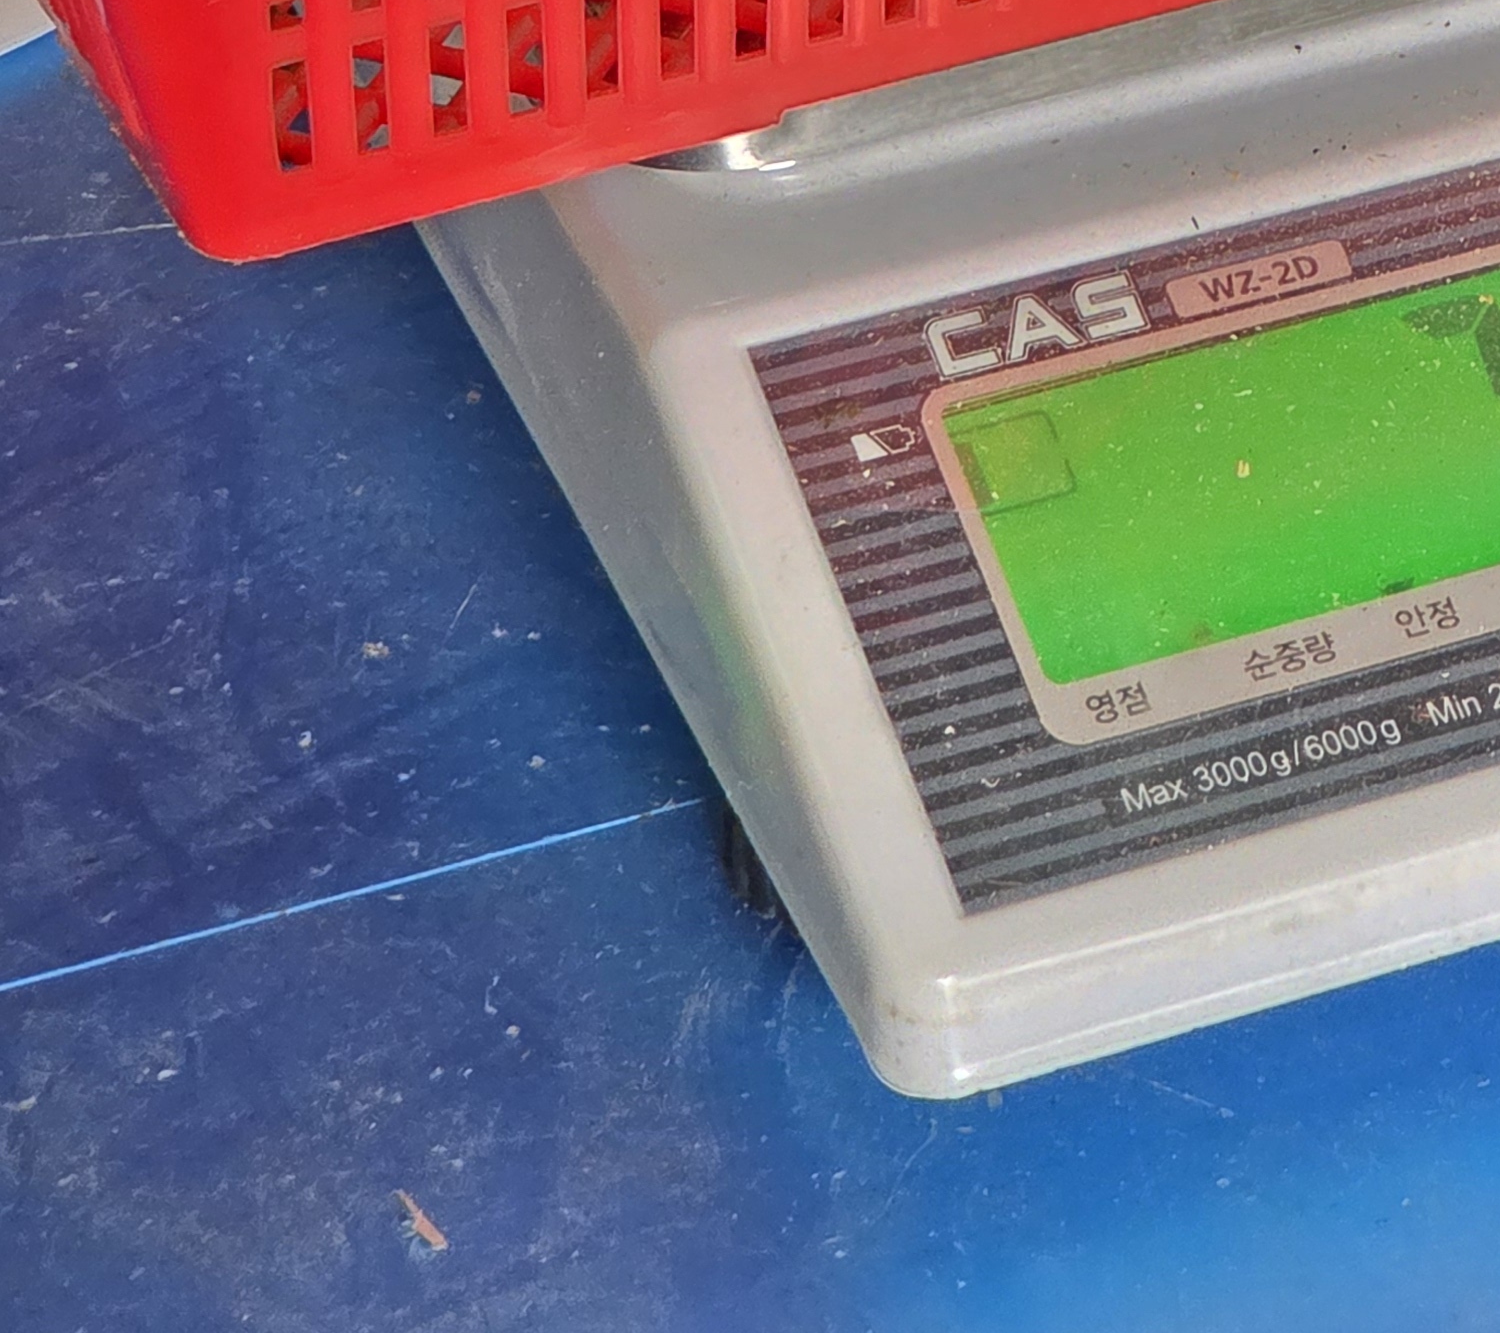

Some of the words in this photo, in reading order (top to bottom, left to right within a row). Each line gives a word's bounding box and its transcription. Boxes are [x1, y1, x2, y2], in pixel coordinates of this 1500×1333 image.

[1199, 255, 1319, 303] WZ-2D
[922, 269, 1151, 381] CAS
[1395, 597, 1461, 638] 안정
[1243, 631, 1337, 681] 순중량
[1085, 682, 1152, 725] 영점
[1120, 777, 1188, 813] Max
[1426, 693, 1481, 726] Min
